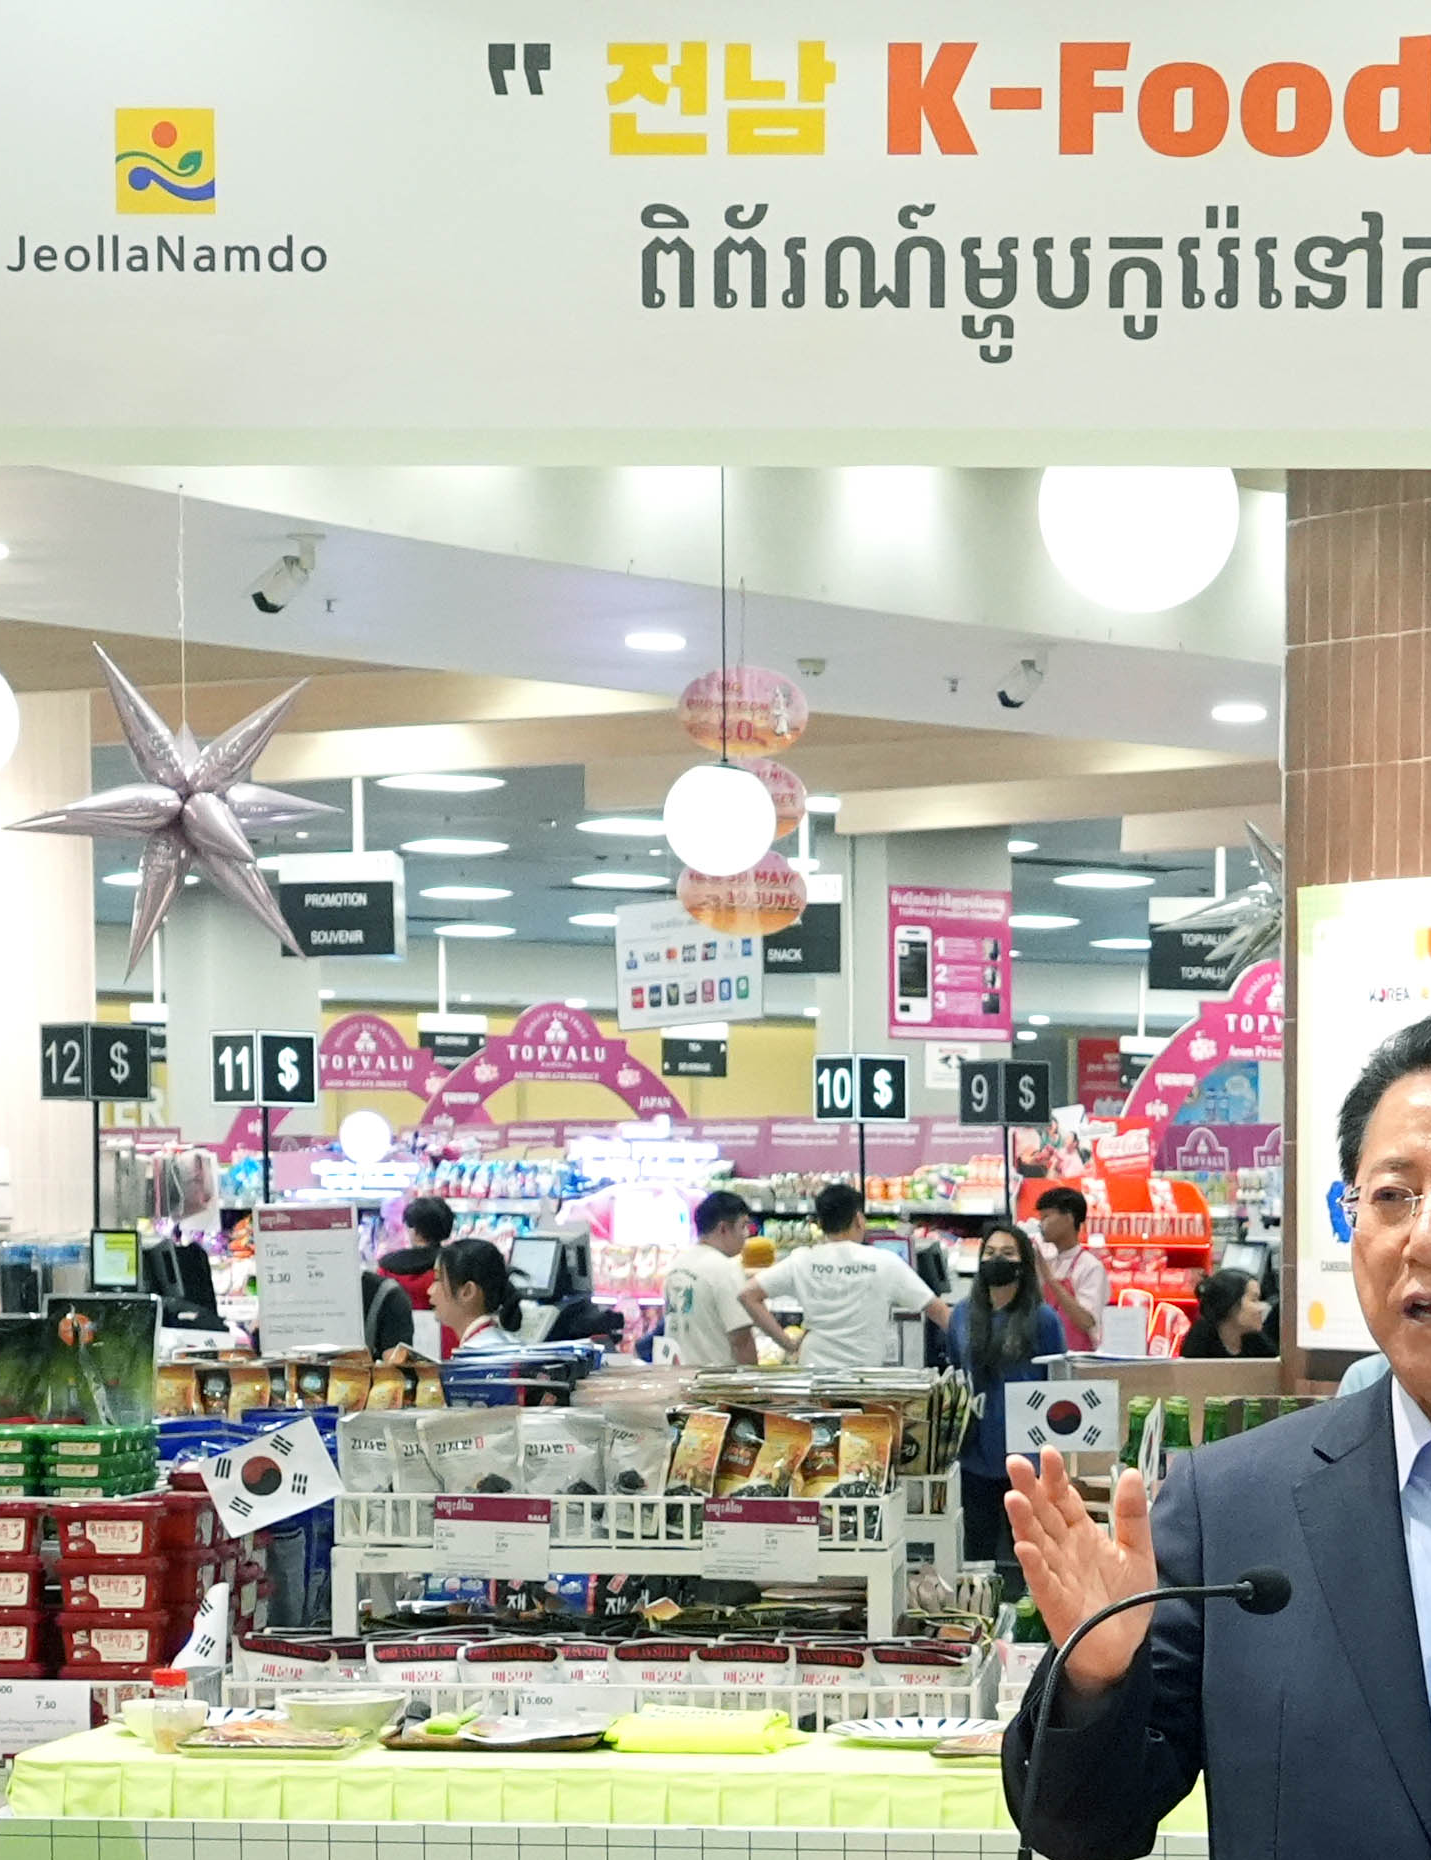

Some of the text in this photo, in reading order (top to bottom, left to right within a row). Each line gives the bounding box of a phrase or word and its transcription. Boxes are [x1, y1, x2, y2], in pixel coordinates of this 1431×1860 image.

[605, 40, 837, 156] 전남
[5, 234, 329, 275] JeollaNamdo
[304, 892, 368, 908] PROMOTION
[310, 929, 365, 945] SOUVENIR
[767, 947, 803, 962] SNACK
[1225, 1013, 1284, 1033] TOPV
[44, 1040, 82, 1085] 12
[320, 1054, 415, 1072] TOPVALU
[507, 1044, 607, 1063] TOPVALU
[218, 1046, 250, 1093] 11
[816, 1067, 851, 1108] 10
[970, 1073, 989, 1113] 9
[812, 1263, 877, 1275] TOO YOUNG
[35, 1700, 57, 1712] 7.50
